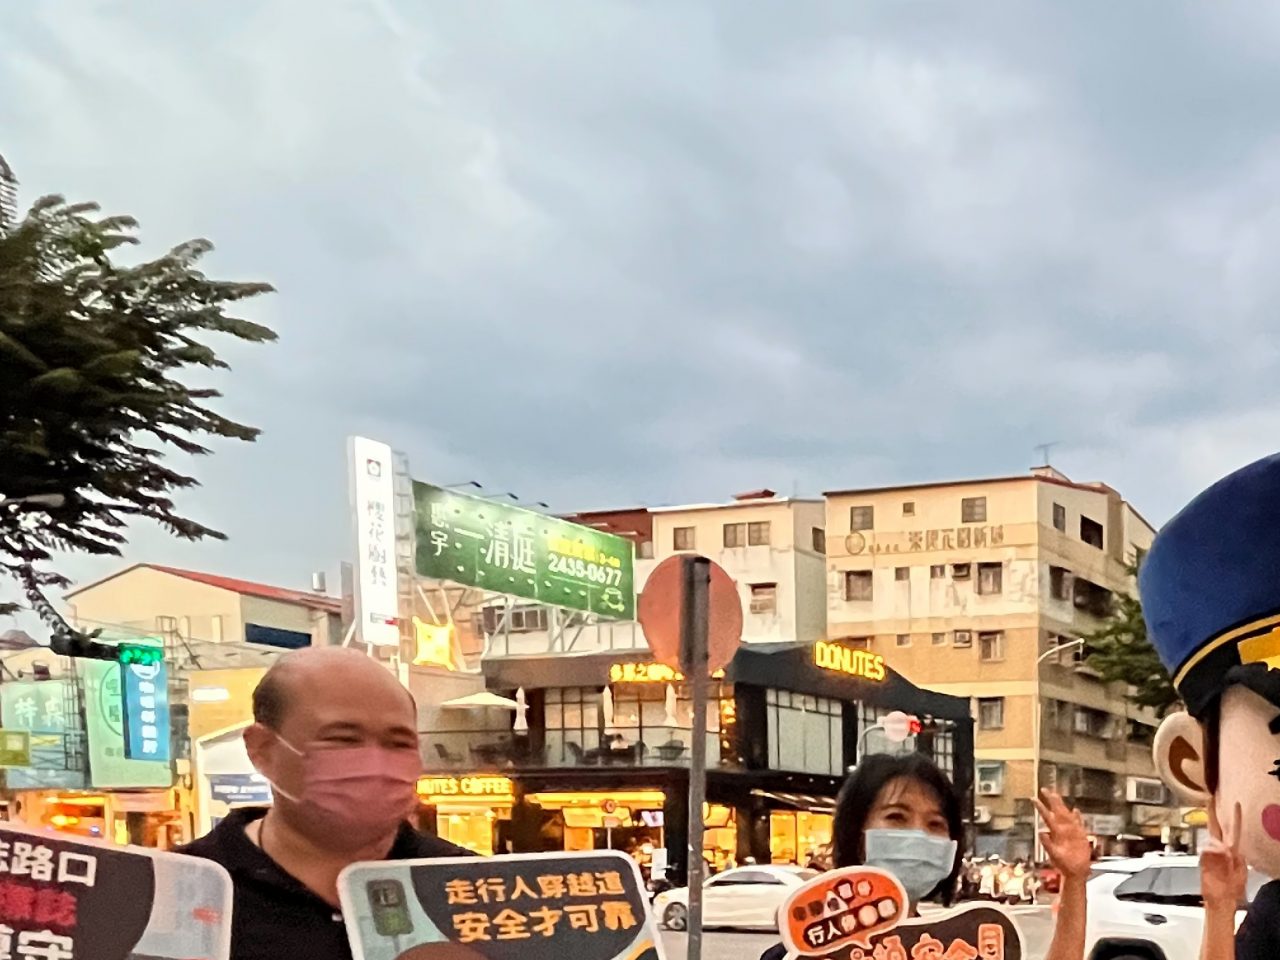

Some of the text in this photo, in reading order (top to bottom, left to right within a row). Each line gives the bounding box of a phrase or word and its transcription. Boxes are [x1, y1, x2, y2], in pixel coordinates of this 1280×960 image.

[547, 552, 622, 587] 2435-0677
[814, 641, 887, 682] DONUTES
[460, 776, 513, 795] COFFEE
[0, 839, 98, 888] 路口
[445, 871, 626, 905] 走行人穿越道
[452, 900, 638, 943] 安全才可靠
